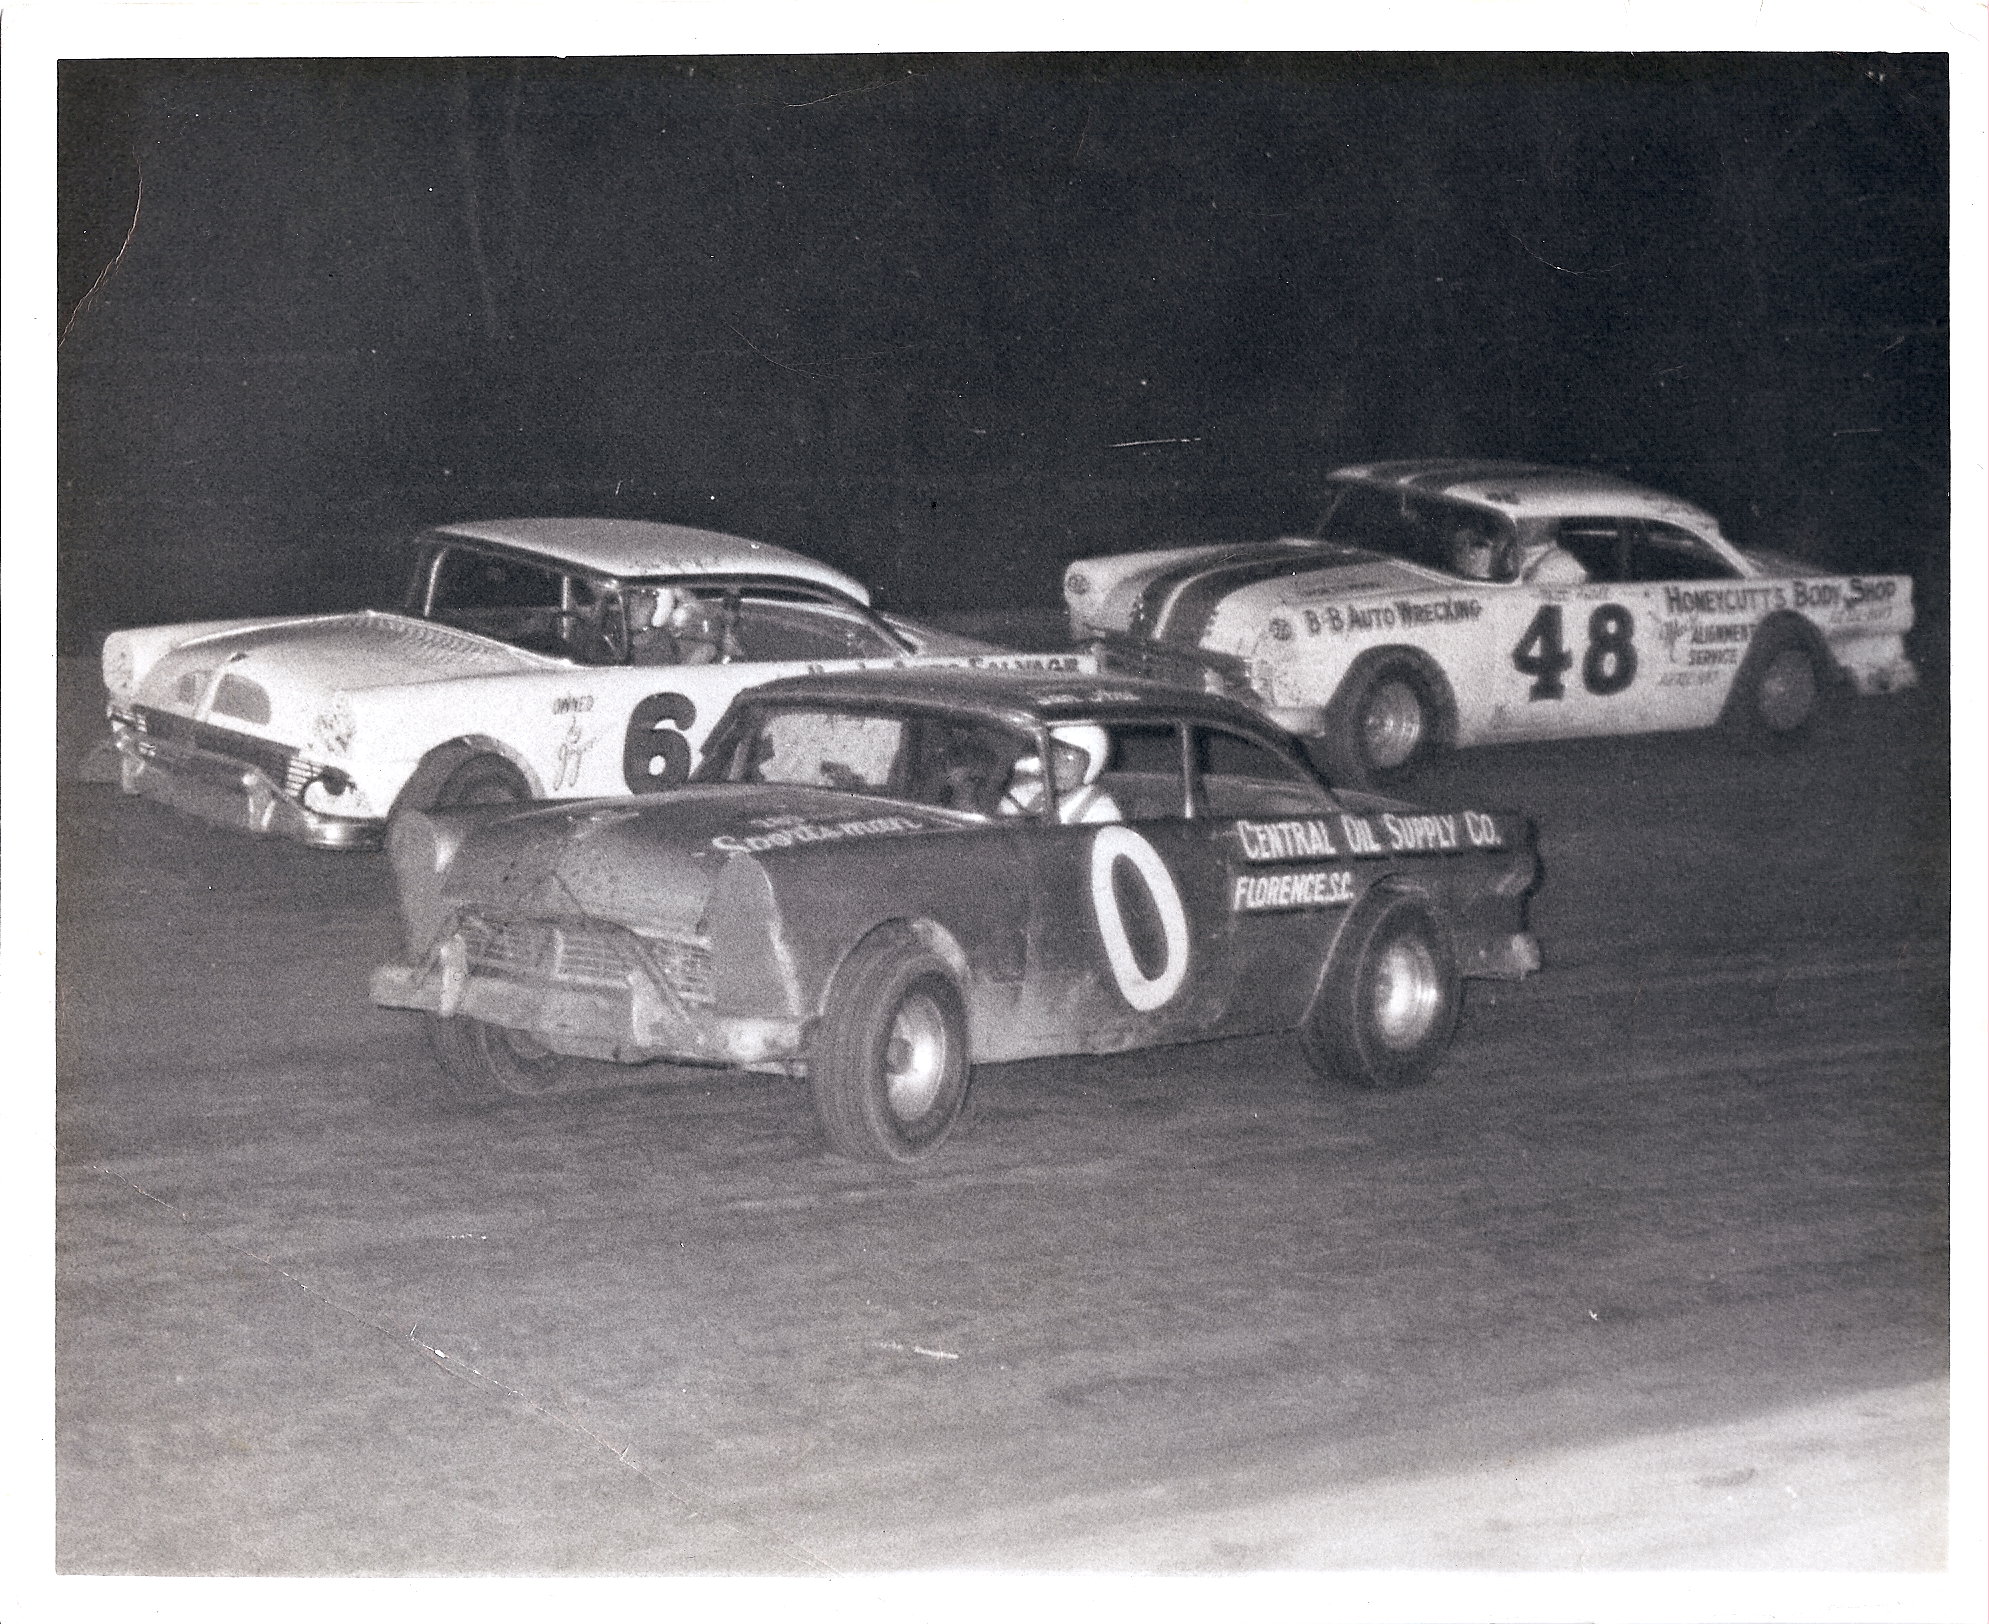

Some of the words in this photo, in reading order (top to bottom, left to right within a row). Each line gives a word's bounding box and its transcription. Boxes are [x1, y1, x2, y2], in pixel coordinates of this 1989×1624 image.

[1793, 579, 1842, 607] BODY
[1849, 577, 1897, 601] SHOP
[1348, 605, 1396, 634] AUTO
[1512, 602, 1638, 702] 48
[1688, 649, 1739, 667] SERVICE
[622, 691, 698, 795] 6
[1237, 820, 1337, 860] CENTRAL
[1341, 814, 1382, 852] OIL
[1382, 813, 1456, 850] SUPPLY
